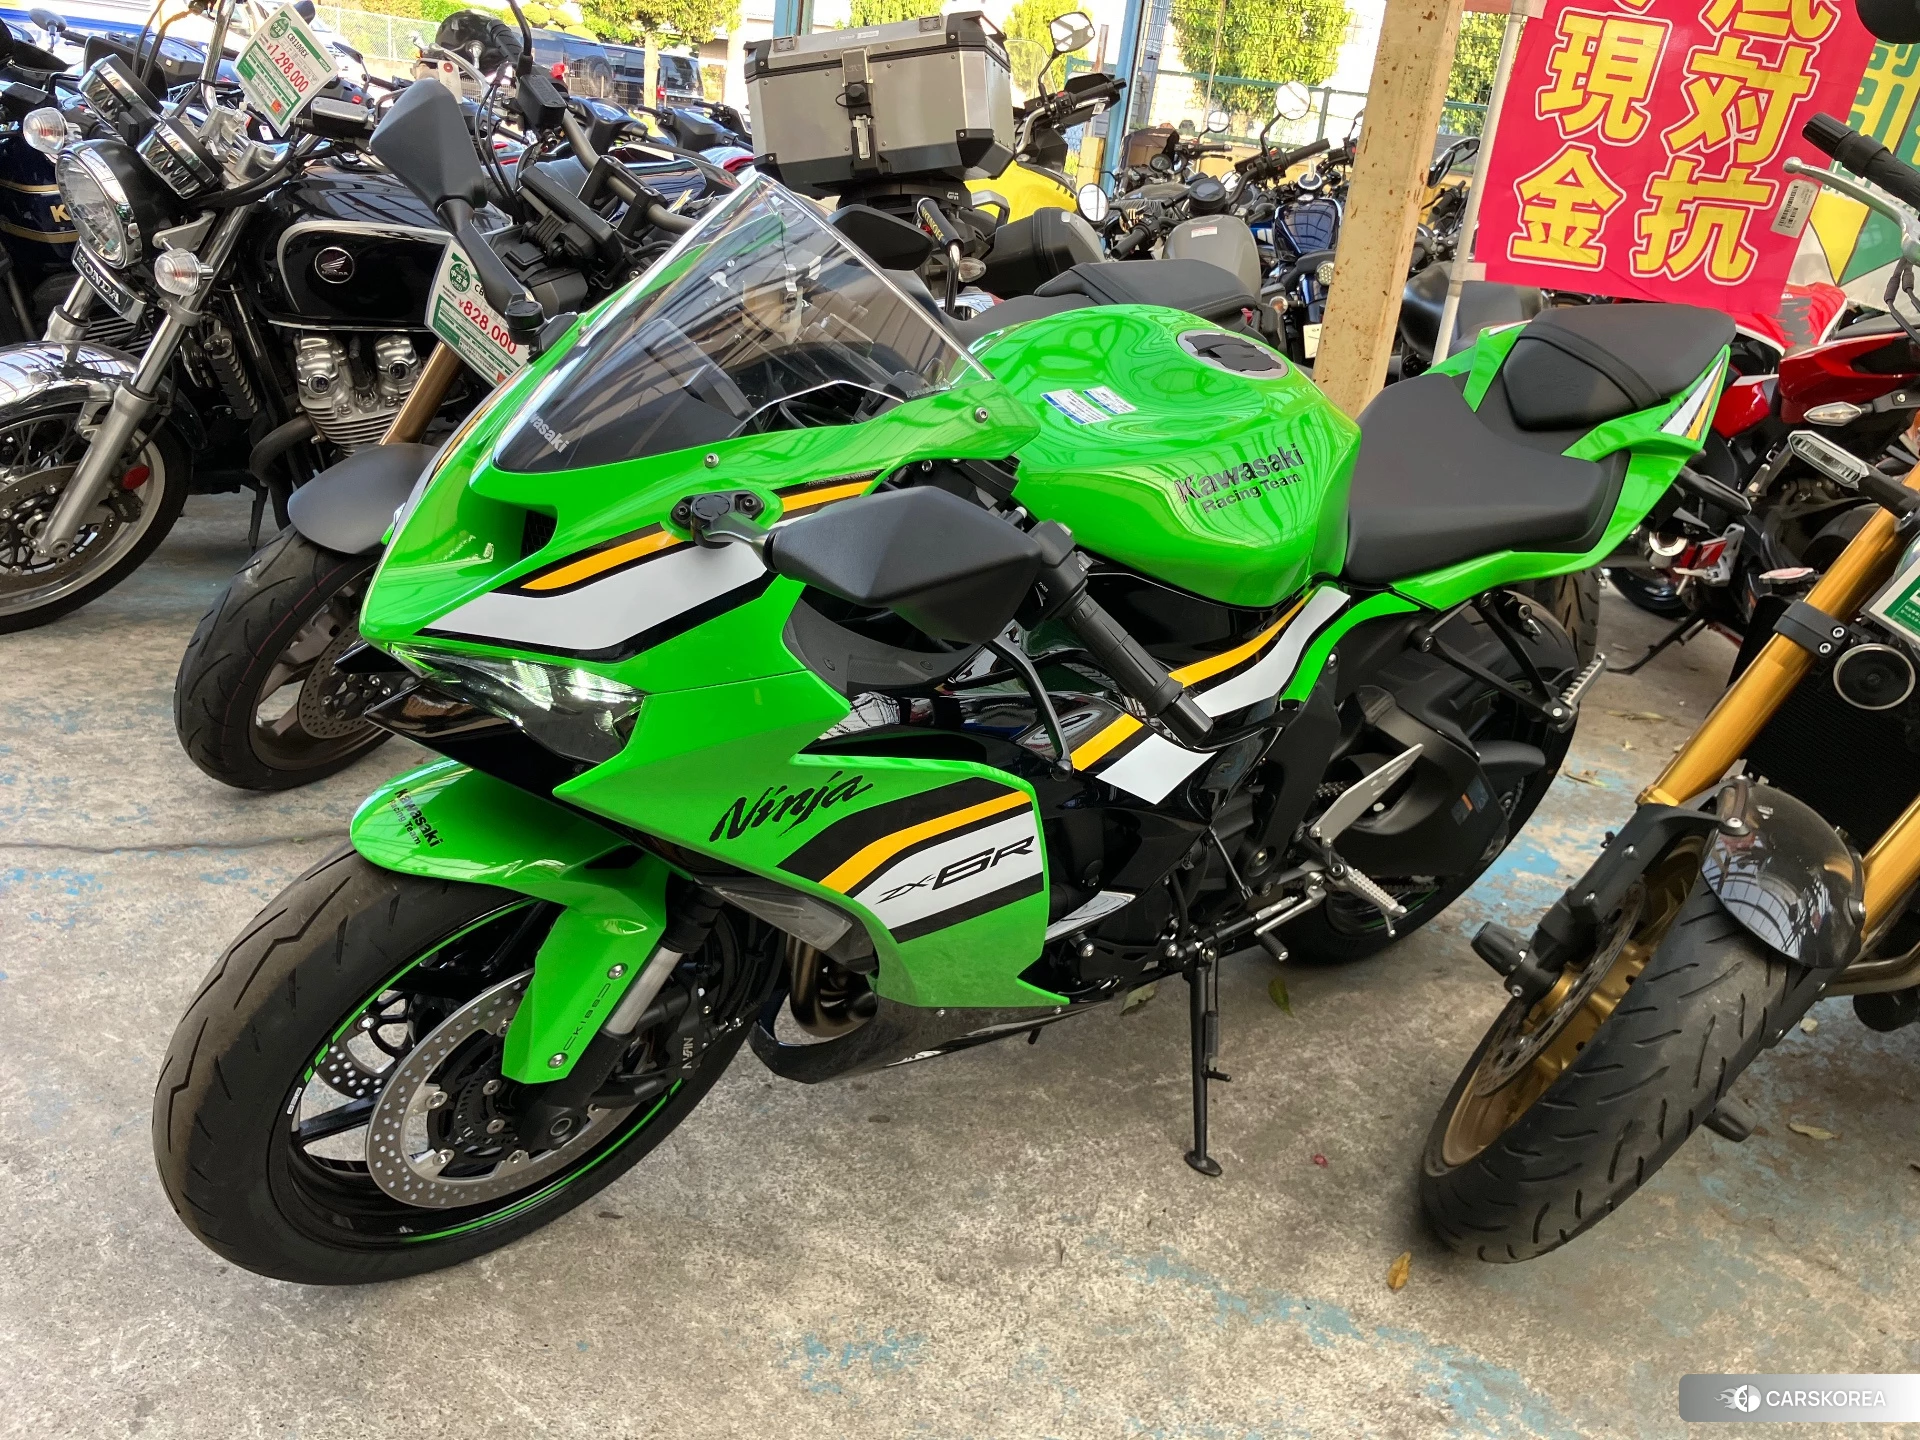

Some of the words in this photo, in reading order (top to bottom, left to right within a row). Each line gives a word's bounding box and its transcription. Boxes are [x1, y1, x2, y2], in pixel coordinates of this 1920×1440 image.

[266, 43, 309, 93] ¥1,298,000
[287, 33, 309, 58] CB1100EX
[1510, 0, 1669, 267] 現金
[76, 251, 121, 306] HONDA
[458, 300, 517, 355] ¥828,000
[1174, 442, 1305, 505] Kawasaki
[1200, 486, 1262, 514] Racing
[1259, 473, 1302, 492] Team
[387, 799, 407, 823] Racing
[404, 820, 421, 845] Team
[394, 788, 444, 847] Kawasaki
[709, 770, 874, 842] Ninja
